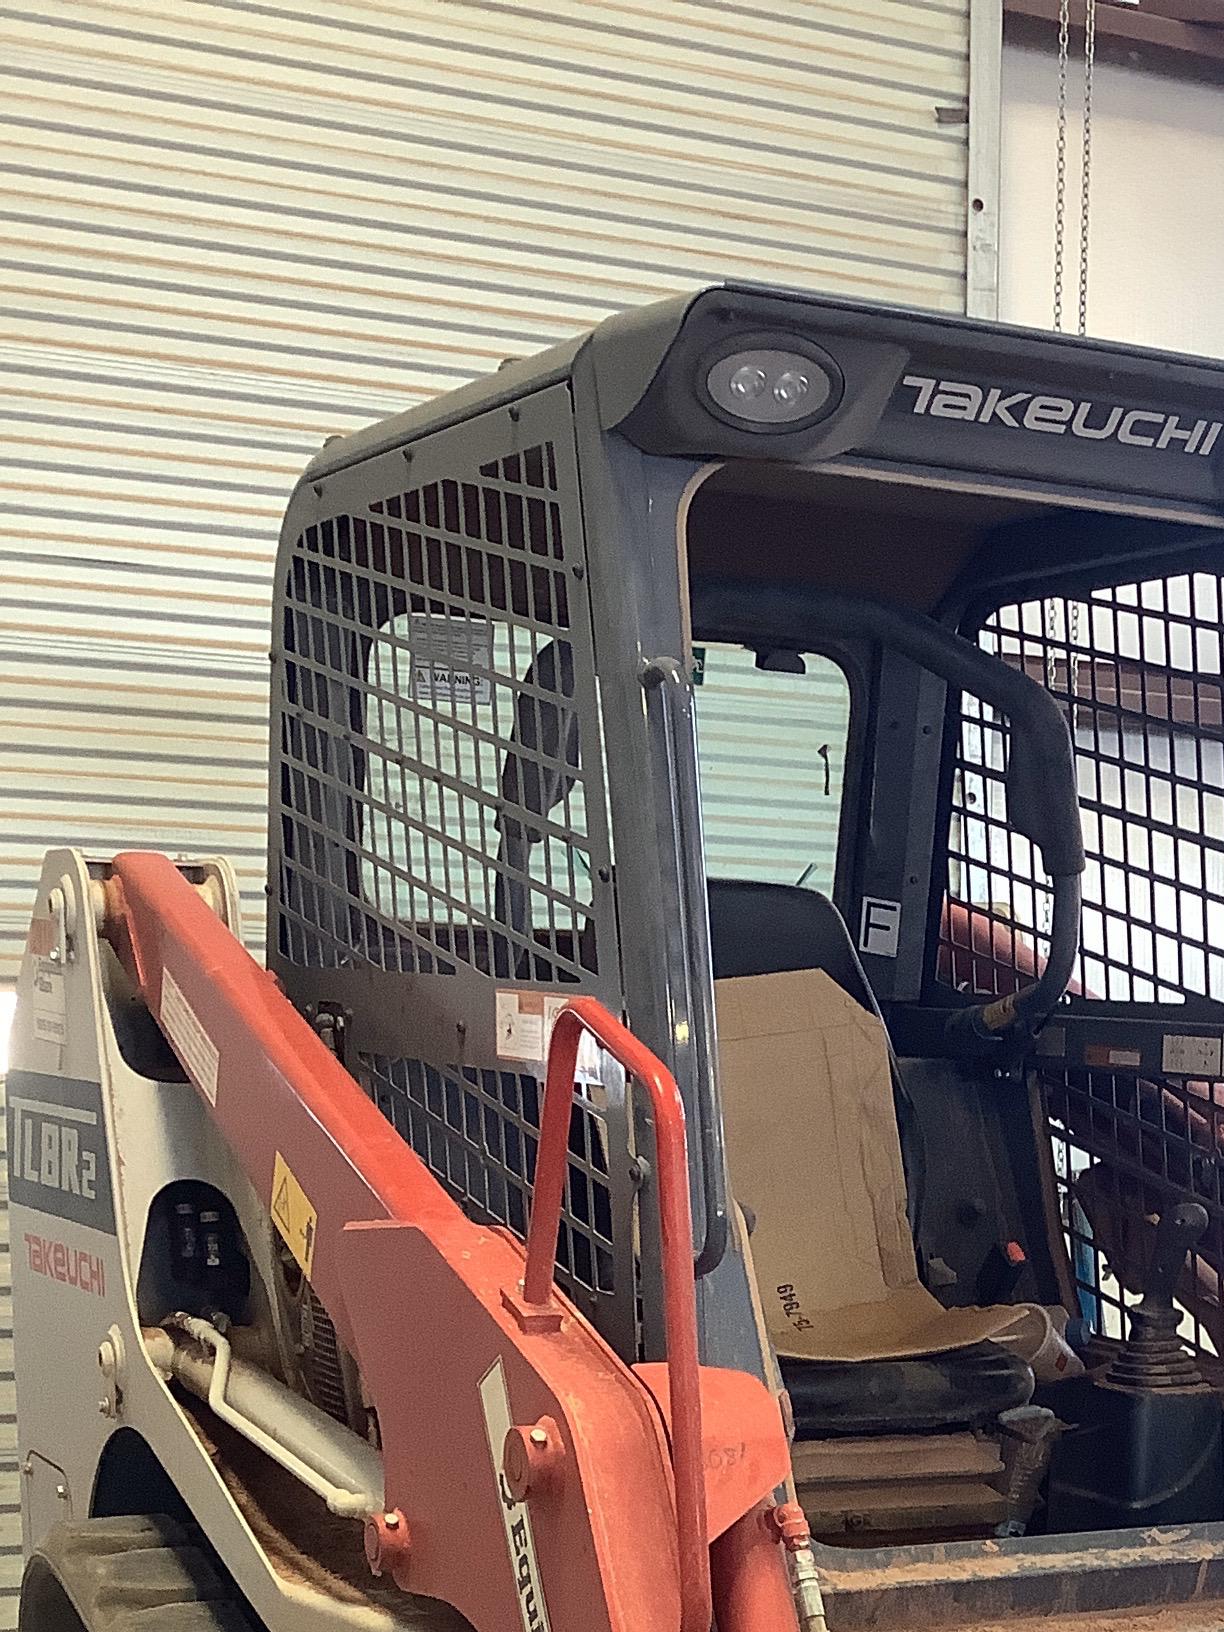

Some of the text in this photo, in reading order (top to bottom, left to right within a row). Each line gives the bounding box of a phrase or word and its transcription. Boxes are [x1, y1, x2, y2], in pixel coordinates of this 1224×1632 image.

[902, 375, 1224, 456] TAKEUCHI
[863, 901, 897, 947] F
[23, 1231, 107, 1298] TAKEUCHI
